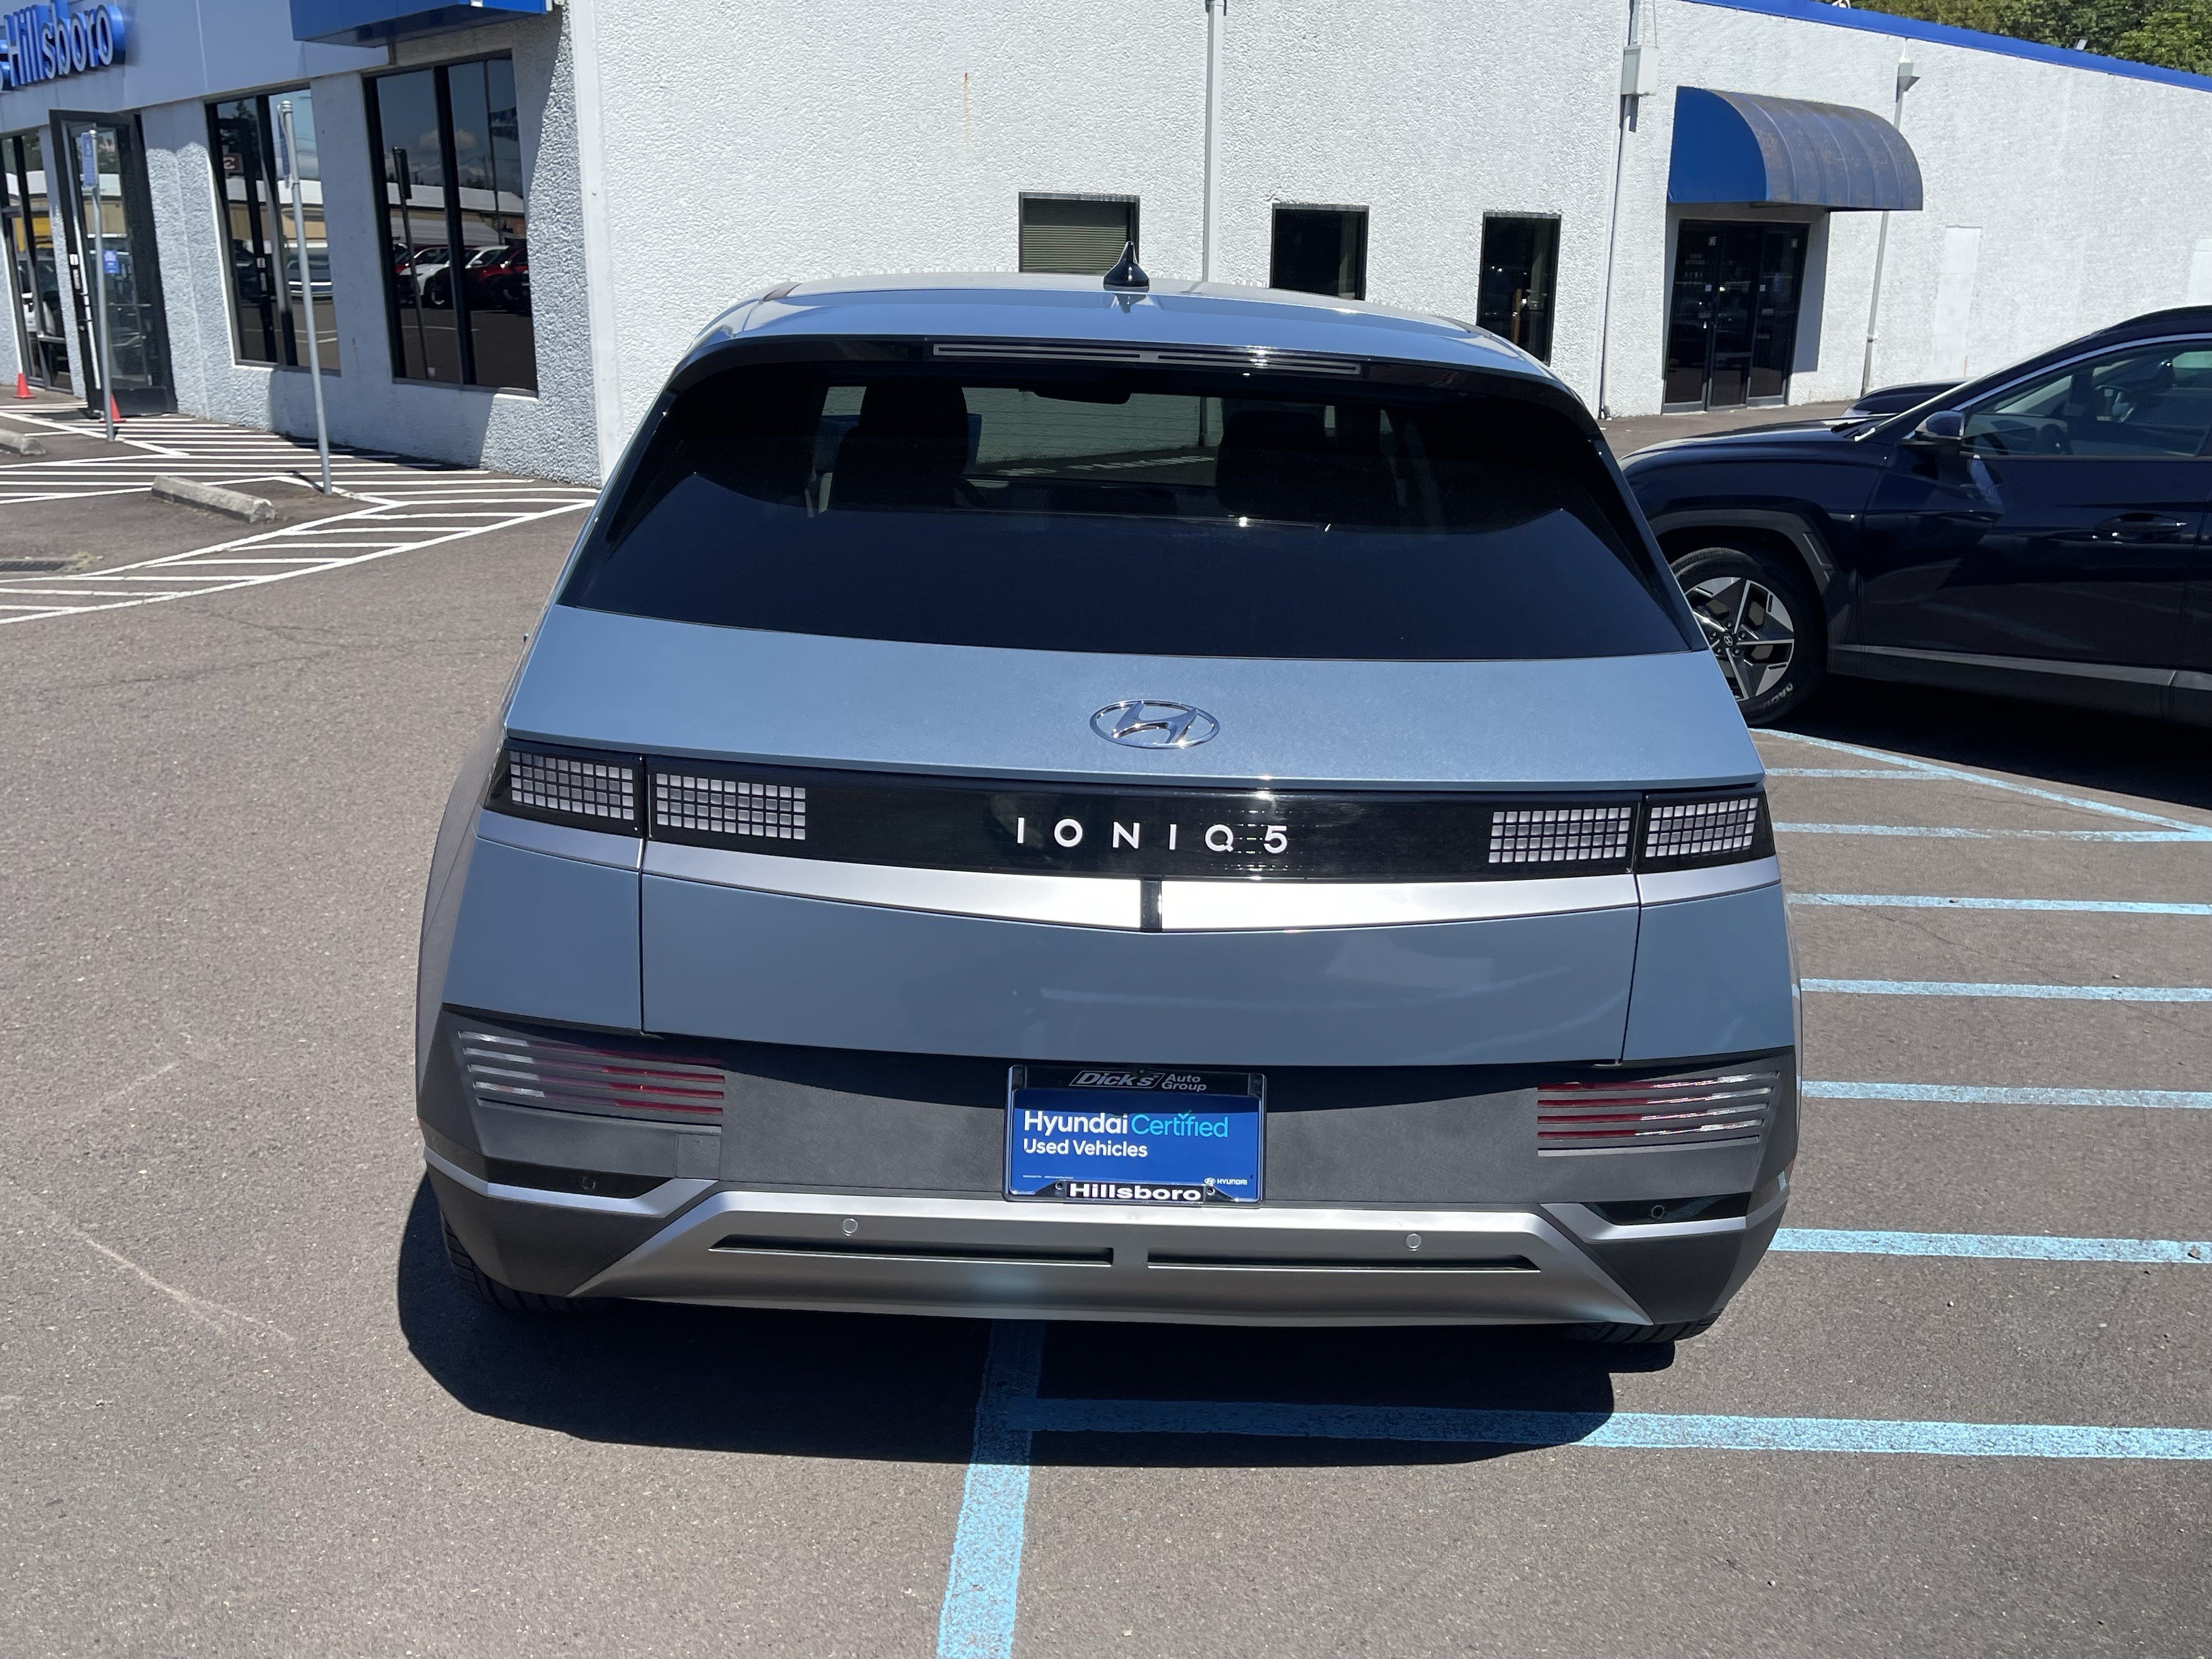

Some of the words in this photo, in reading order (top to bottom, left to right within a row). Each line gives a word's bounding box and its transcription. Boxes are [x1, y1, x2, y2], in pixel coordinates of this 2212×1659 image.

[4, 0, 114, 87] Hillsboro
[1161, 1081, 1207, 1092] Group
[1165, 1074, 1201, 1083] Auto
[1024, 1110, 1128, 1136] Hyundai
[1131, 1112, 1228, 1137] Certified
[1024, 1138, 1069, 1154] Used
[1073, 1139, 1148, 1157] Vehicles
[1070, 1183, 1201, 1201] Hillsboro
